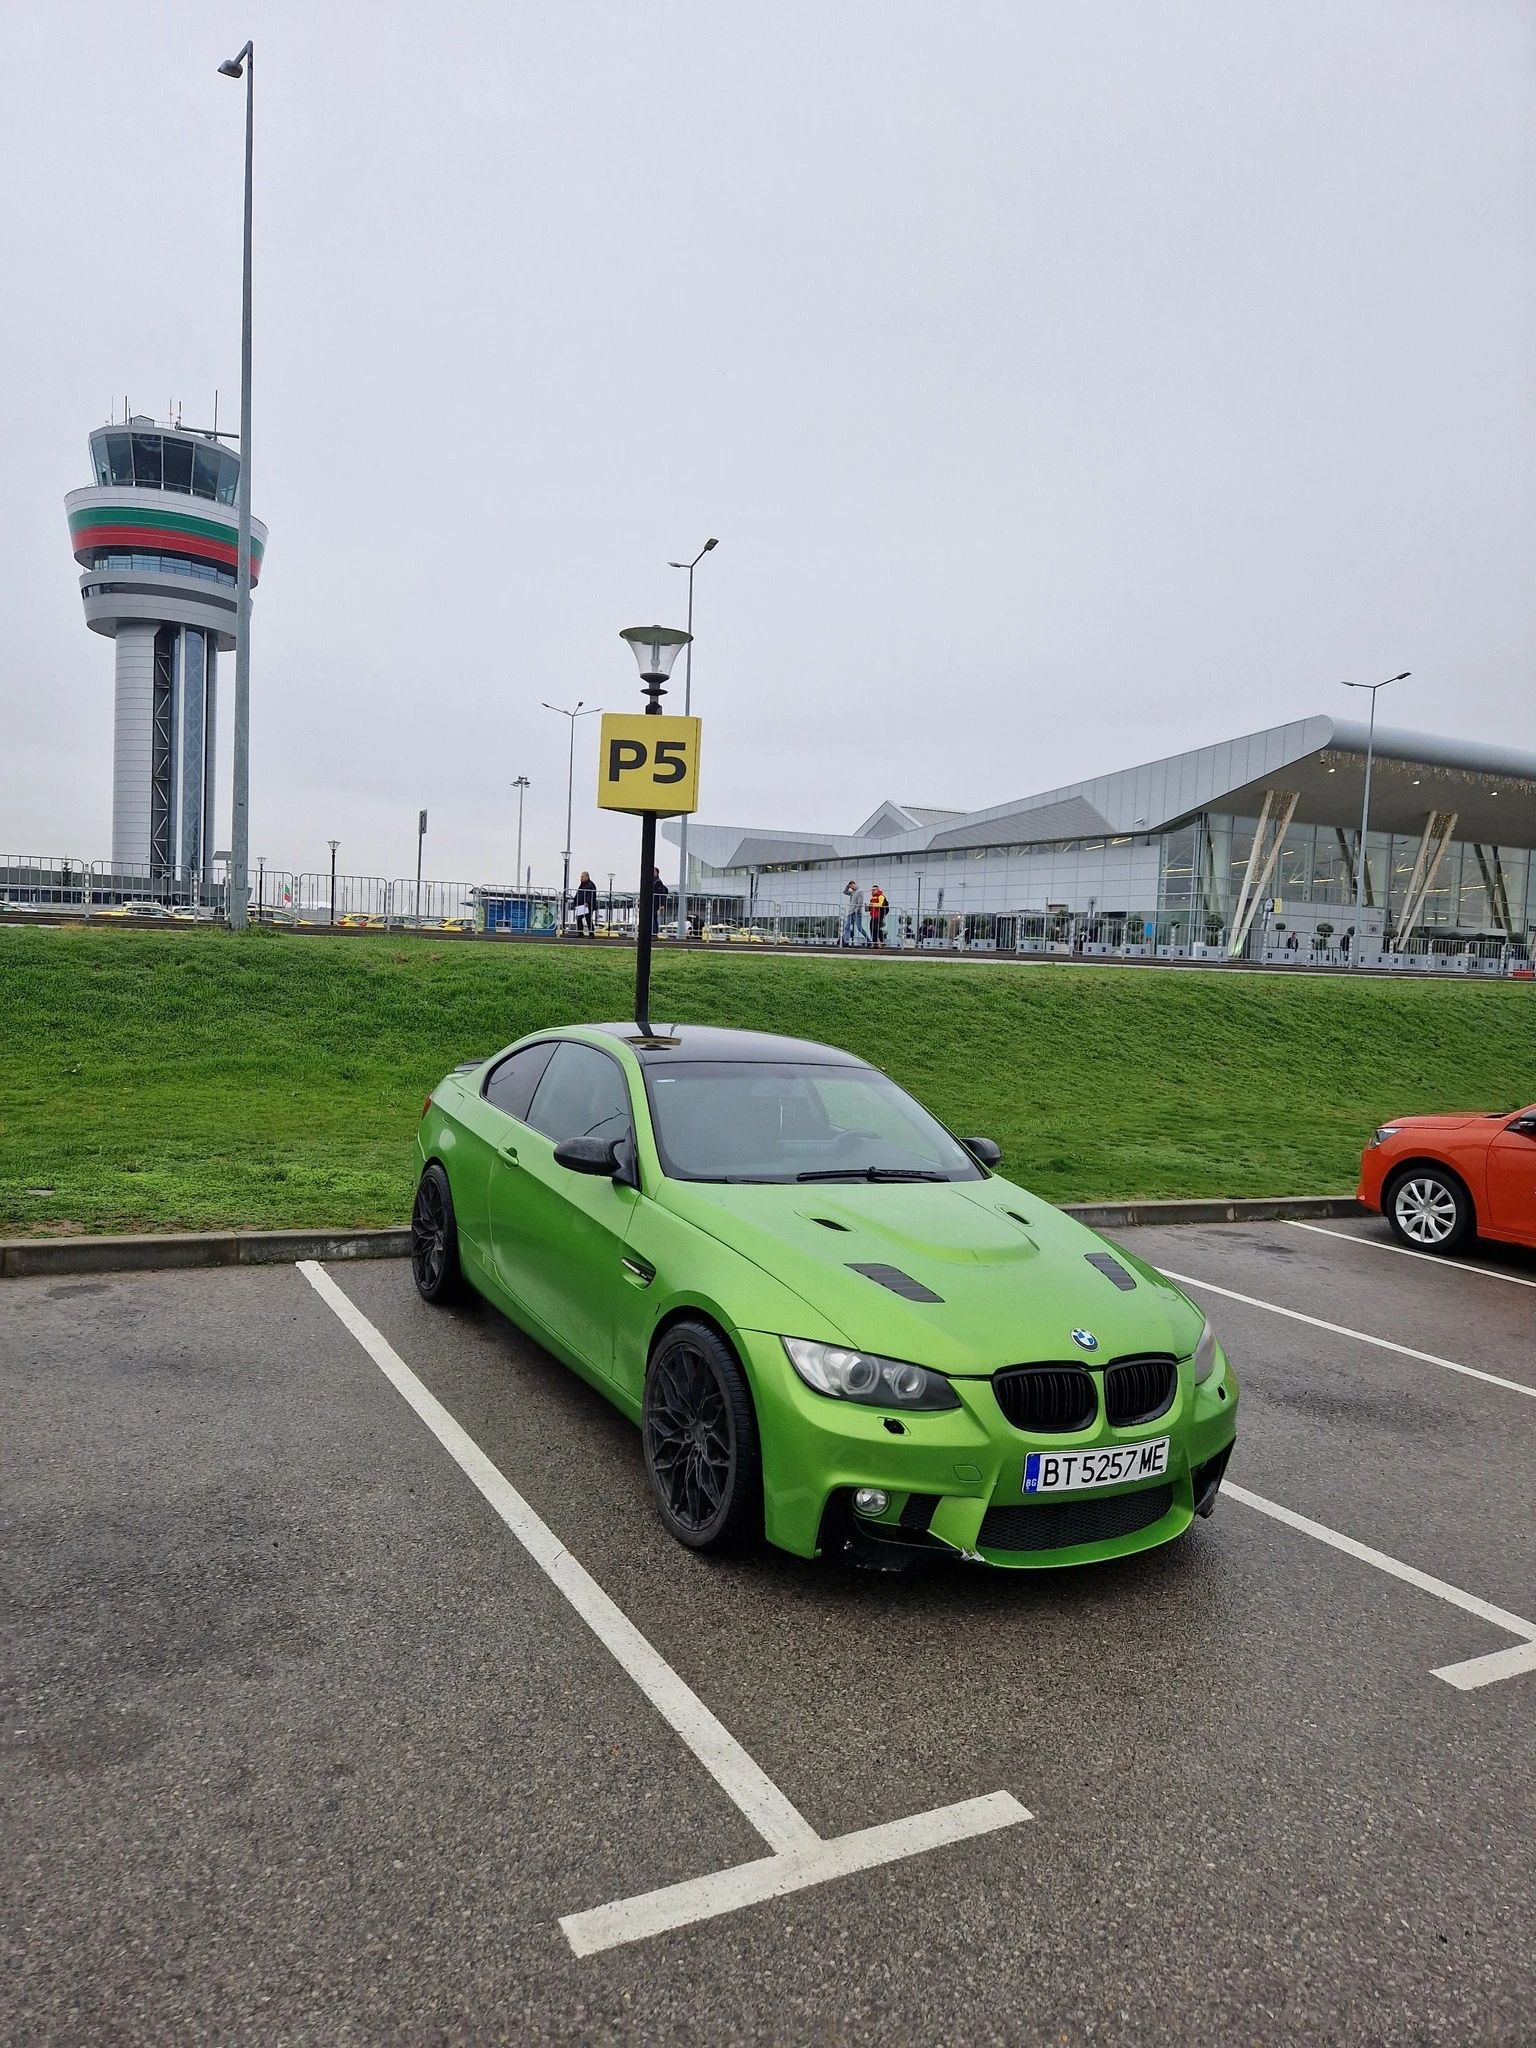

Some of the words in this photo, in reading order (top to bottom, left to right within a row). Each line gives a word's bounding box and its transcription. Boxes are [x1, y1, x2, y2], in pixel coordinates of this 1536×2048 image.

[608, 739, 687, 784] P5
[1026, 1478, 1037, 1487] BG
[1043, 1457, 1077, 1486] BT
[1081, 1450, 1137, 1483] 5257
[1139, 1441, 1166, 1474] ME
